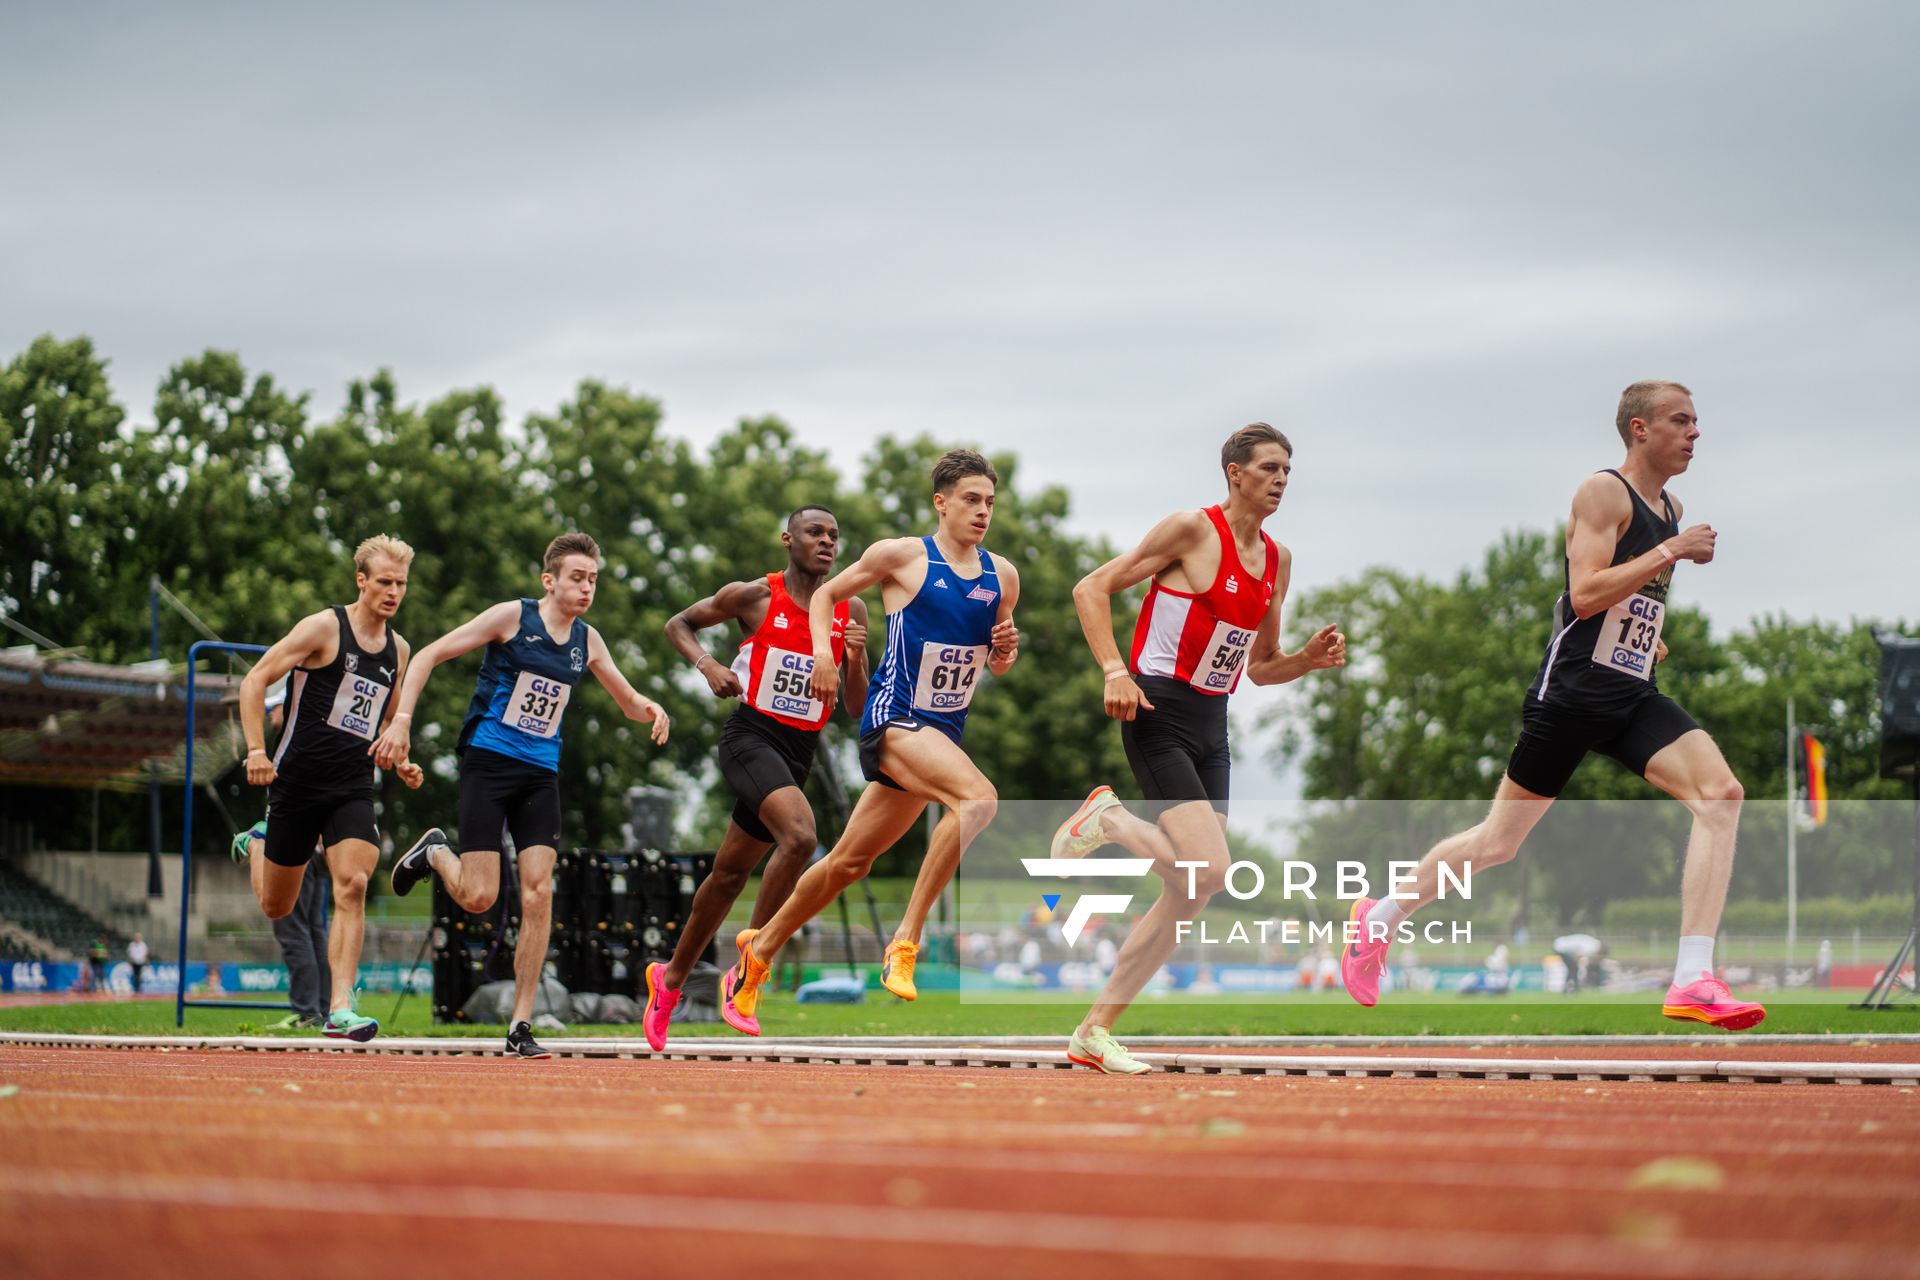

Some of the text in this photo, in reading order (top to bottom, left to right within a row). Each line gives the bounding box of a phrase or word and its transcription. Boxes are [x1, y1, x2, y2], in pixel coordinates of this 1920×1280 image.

[1629, 598, 1659, 622] GLS
[1226, 629, 1251, 648] GLS
[1618, 616, 1656, 653] 133
[782, 654, 814, 673] GLS
[939, 648, 974, 665] GLS
[1211, 645, 1245, 672] 548
[353, 679, 379, 698] GLS
[531, 678, 561, 698] GLS
[931, 665, 976, 691] 614
[349, 695, 372, 719] 20
[520, 692, 559, 720] 331
